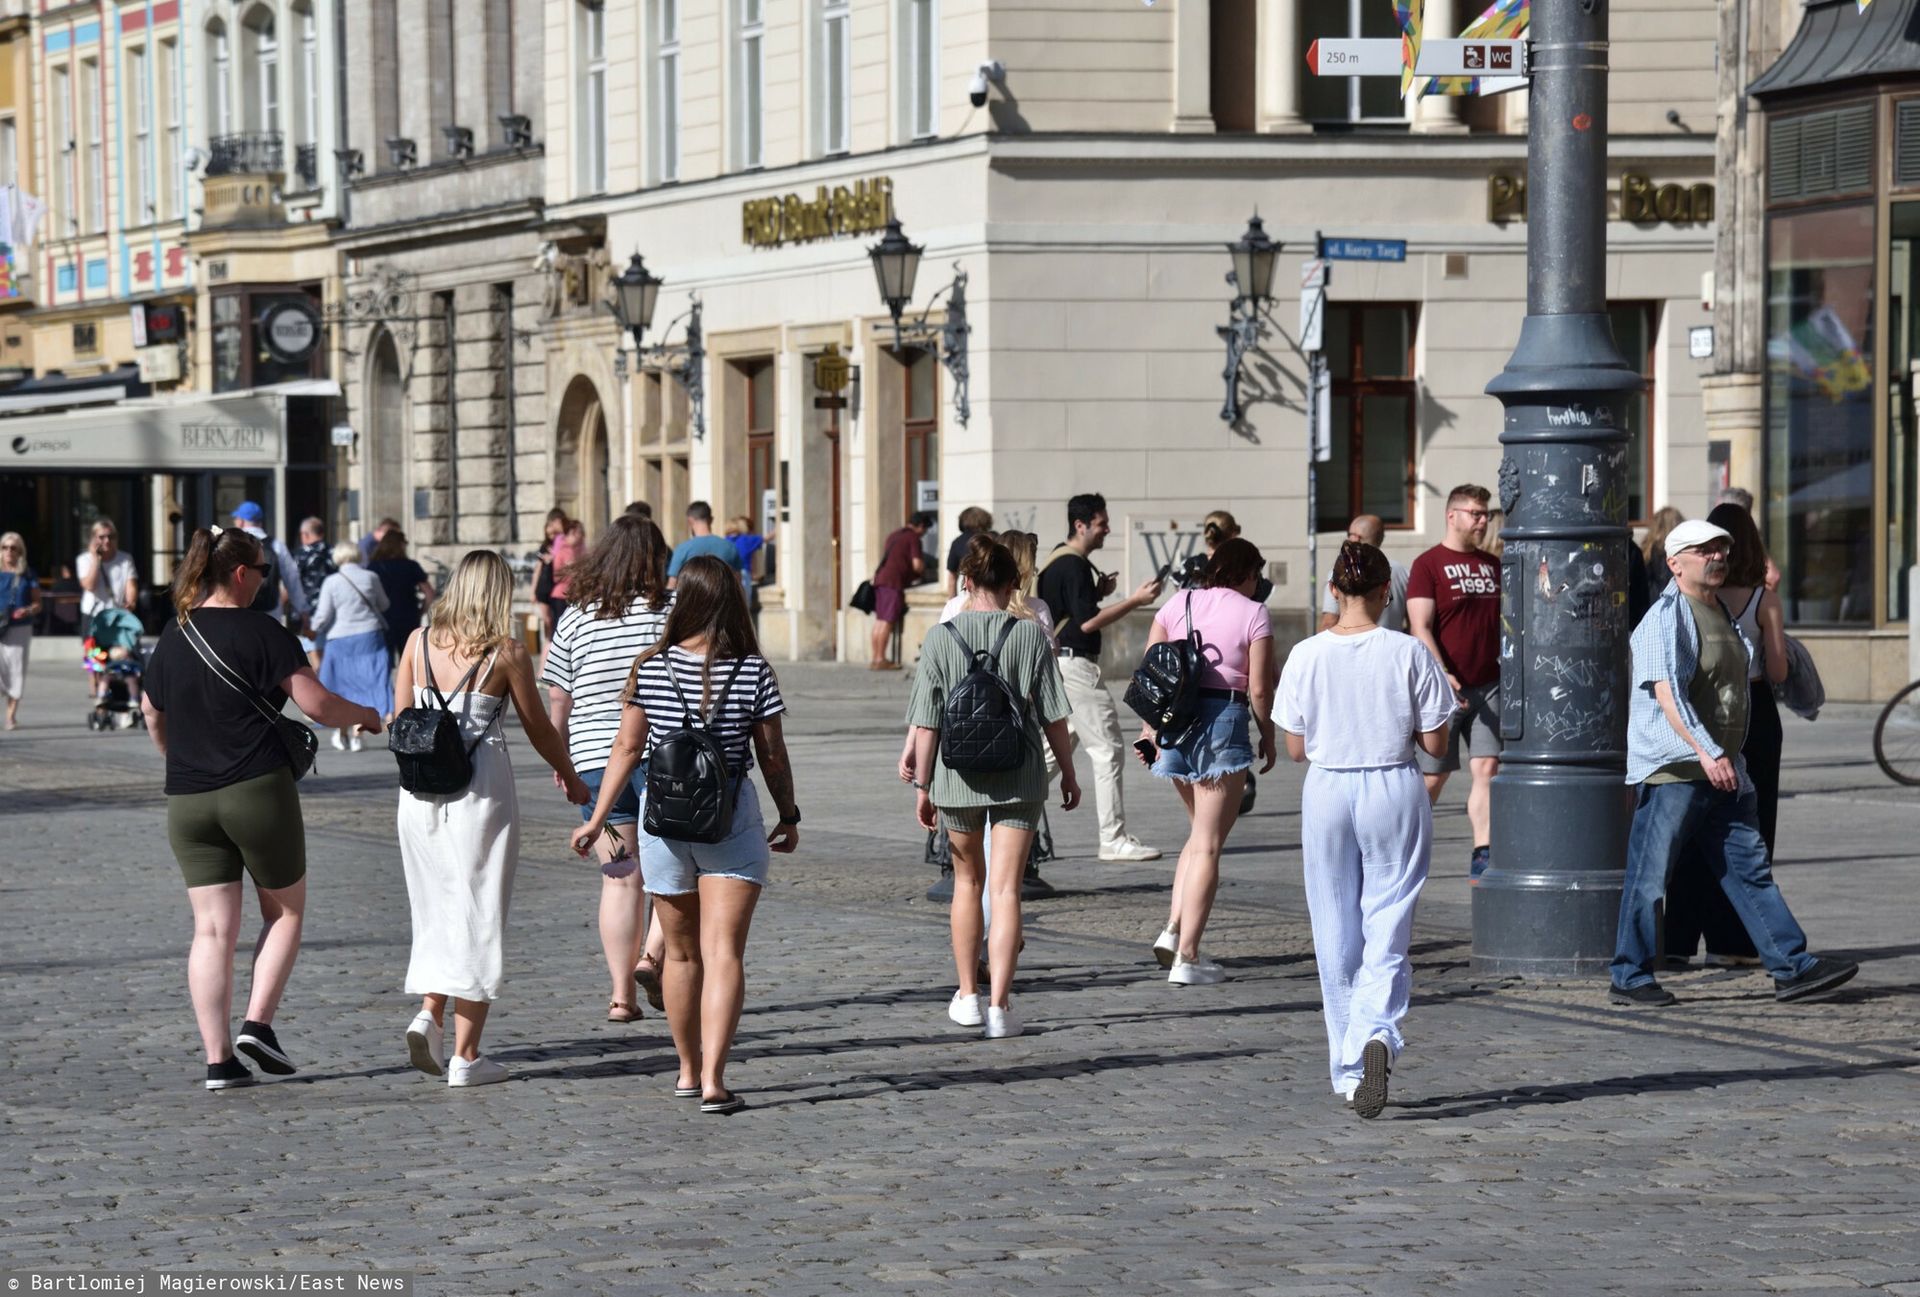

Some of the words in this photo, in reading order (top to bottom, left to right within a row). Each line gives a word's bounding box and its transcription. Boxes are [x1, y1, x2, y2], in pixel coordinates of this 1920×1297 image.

[1326, 52, 1346, 64] 250
[1348, 54, 1359, 64] m
[1491, 52, 1511, 63] WC
[181, 423, 265, 448] BERNARD
[671, 781, 684, 792] M
